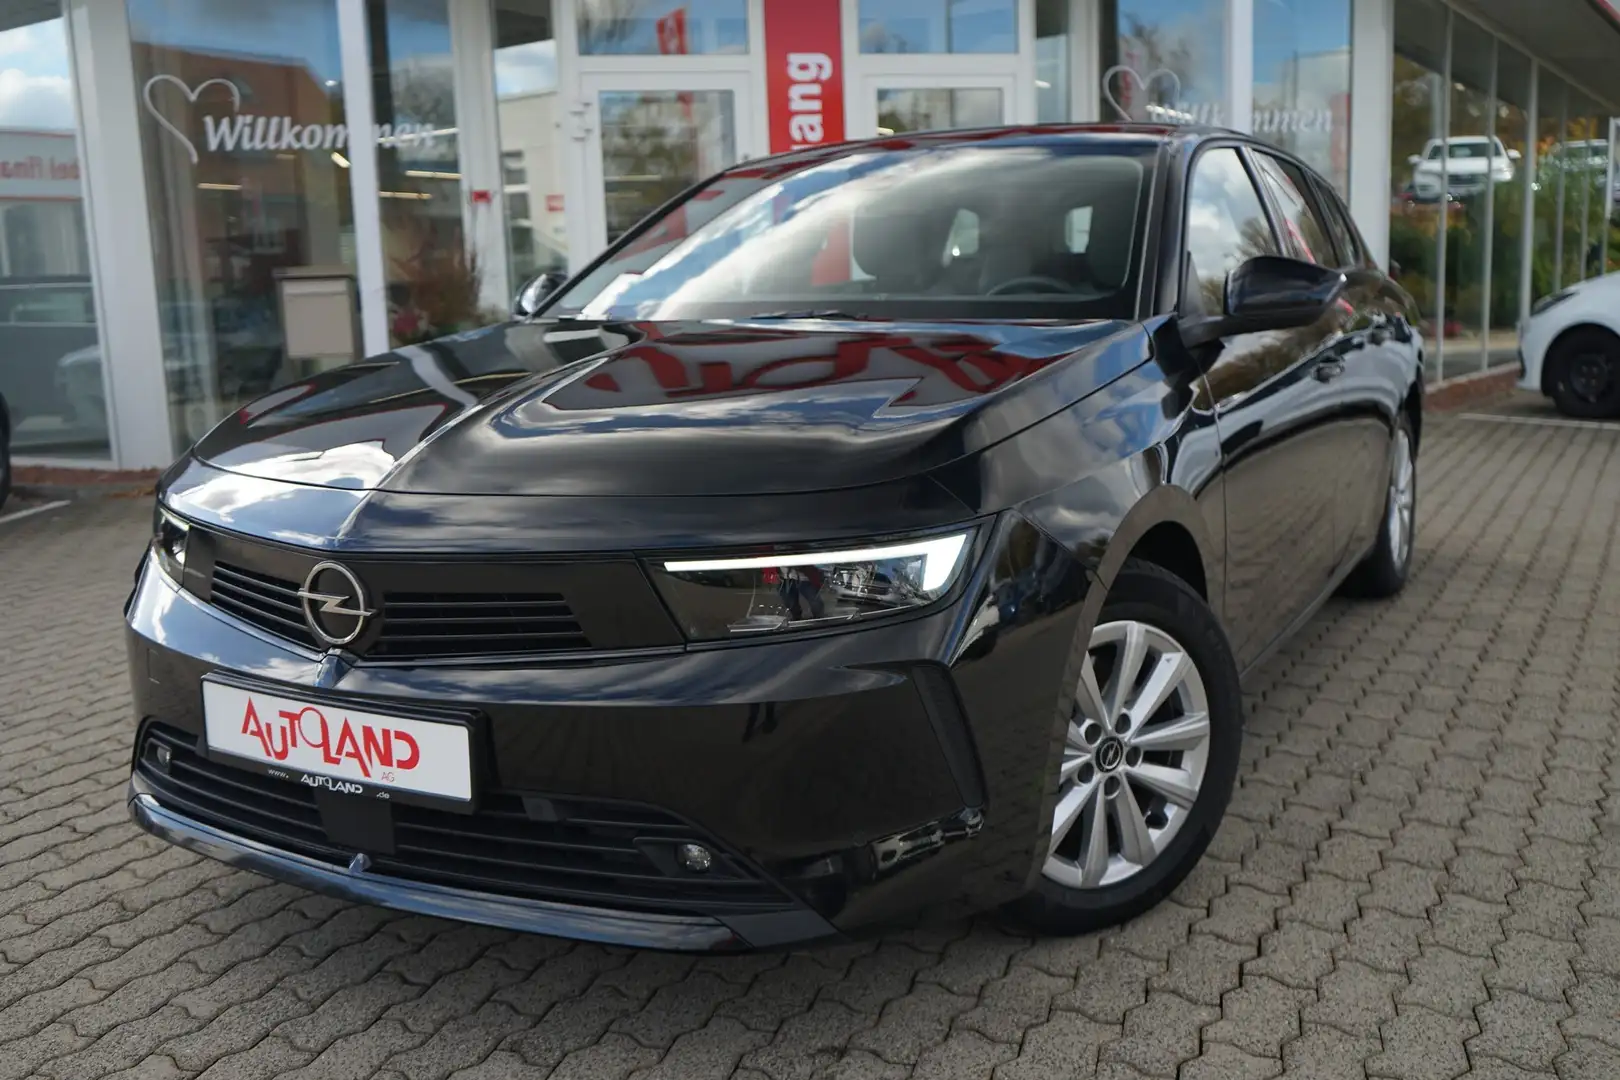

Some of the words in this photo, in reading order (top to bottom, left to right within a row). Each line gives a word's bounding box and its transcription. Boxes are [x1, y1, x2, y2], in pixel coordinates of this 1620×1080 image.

[786, 53, 833, 149] ang
[241, 696, 420, 778] AUTOLAND
[301, 774, 363, 794] AUTOLAND
[381, 772, 395, 782] AG
